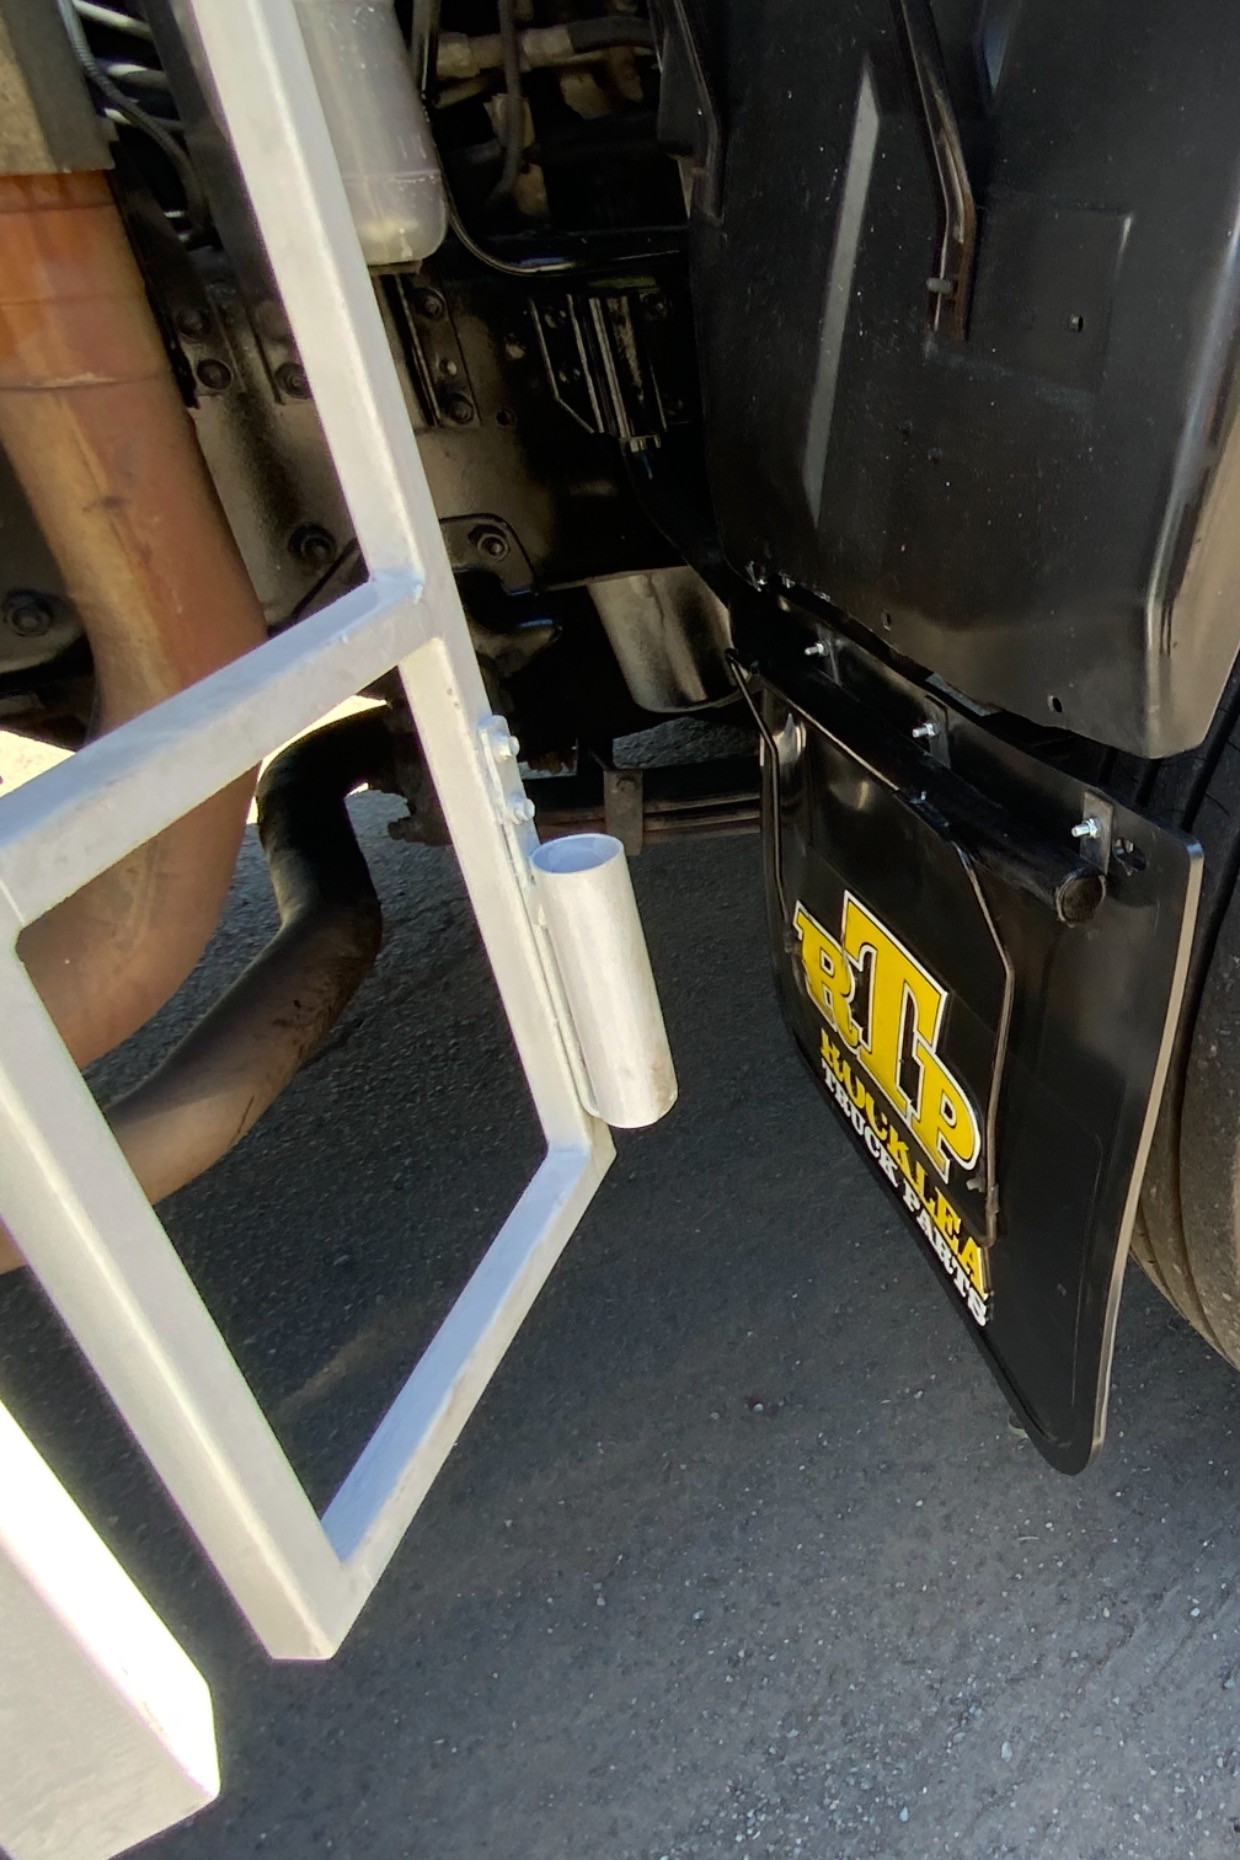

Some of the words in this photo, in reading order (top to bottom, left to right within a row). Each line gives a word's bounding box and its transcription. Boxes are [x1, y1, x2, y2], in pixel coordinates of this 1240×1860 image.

[792, 889, 982, 1185] RTP
[821, 1057, 900, 1189] TRUCK
[902, 1187, 989, 1328] PARTS
